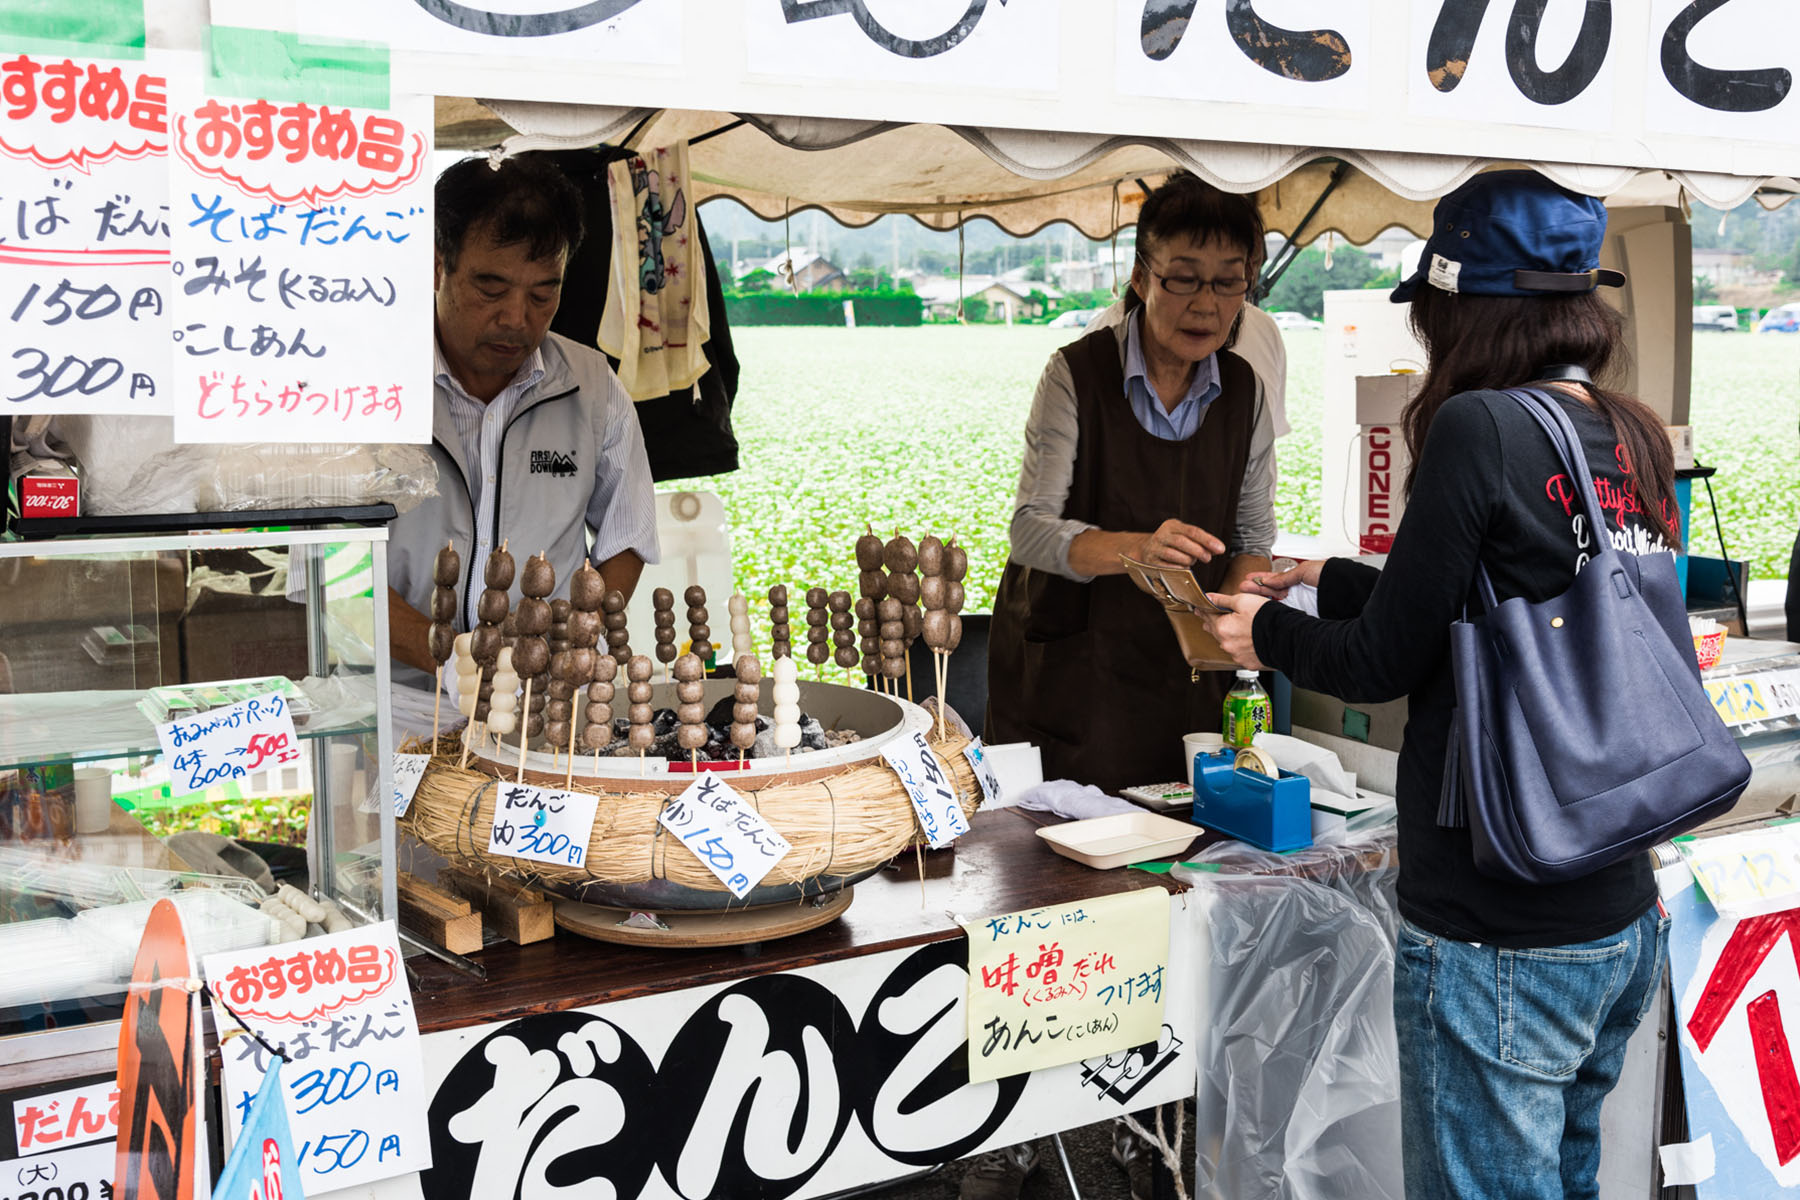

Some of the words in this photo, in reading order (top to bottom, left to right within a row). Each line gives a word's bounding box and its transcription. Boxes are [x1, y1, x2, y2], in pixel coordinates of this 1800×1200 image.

[0, 54, 167, 133] すすめ品
[194, 98, 405, 173] おすすめ品
[188, 193, 425, 246] そばだんご
[1703, 682, 1765, 716] イス
[504, 787, 571, 813] だんご
[517, 825, 583, 864] 300円
[225, 945, 382, 1005] おすすめ品
[1096, 965, 1165, 1006] つけます
[18, 1161, 58, 1187] (大)
